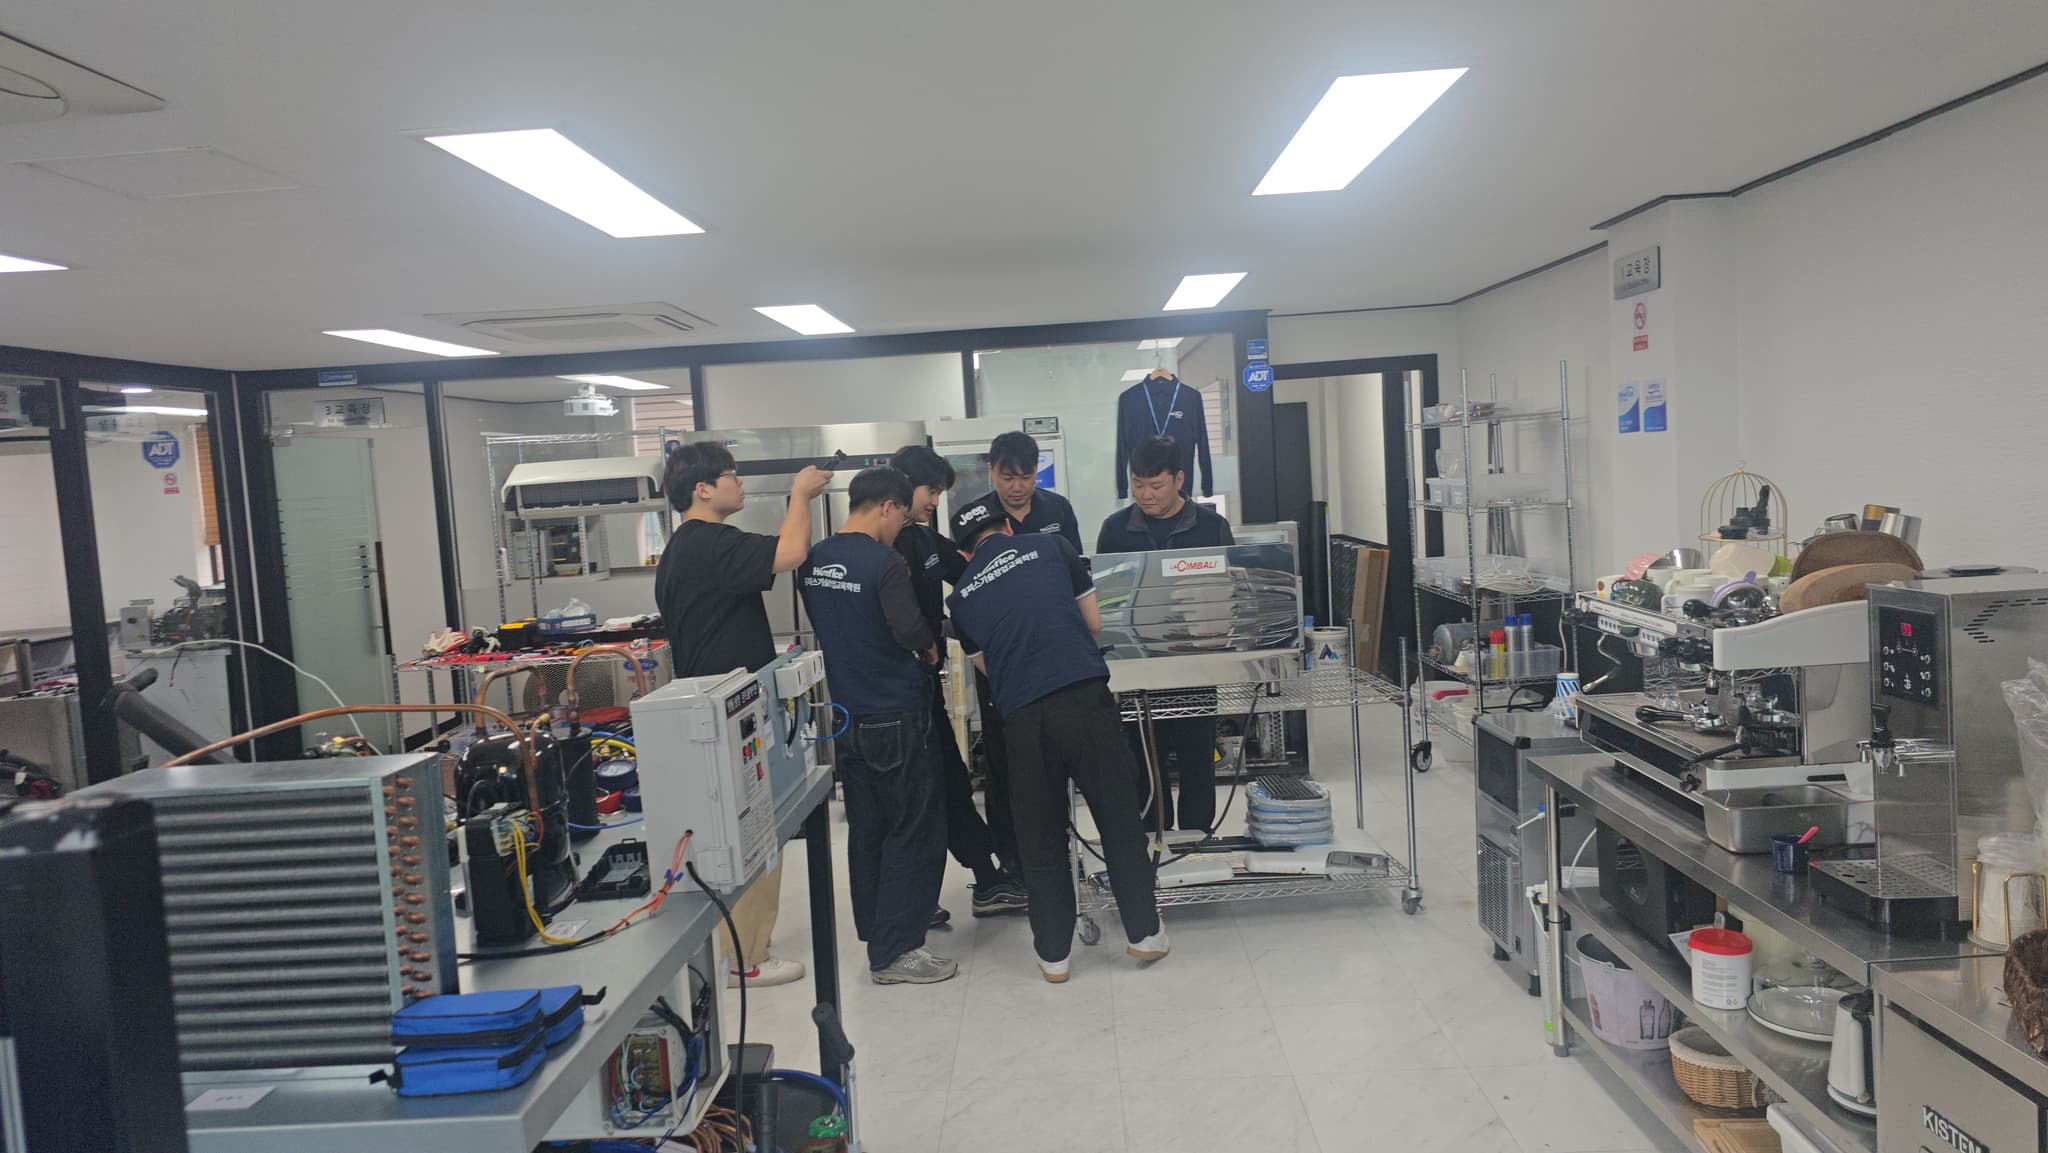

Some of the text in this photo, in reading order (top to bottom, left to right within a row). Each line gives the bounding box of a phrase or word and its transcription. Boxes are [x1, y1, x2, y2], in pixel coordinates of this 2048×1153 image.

[1248, 370, 1269, 382] ADT
[149, 442, 175, 457] ADT
[959, 505, 987, 526] Jeep
